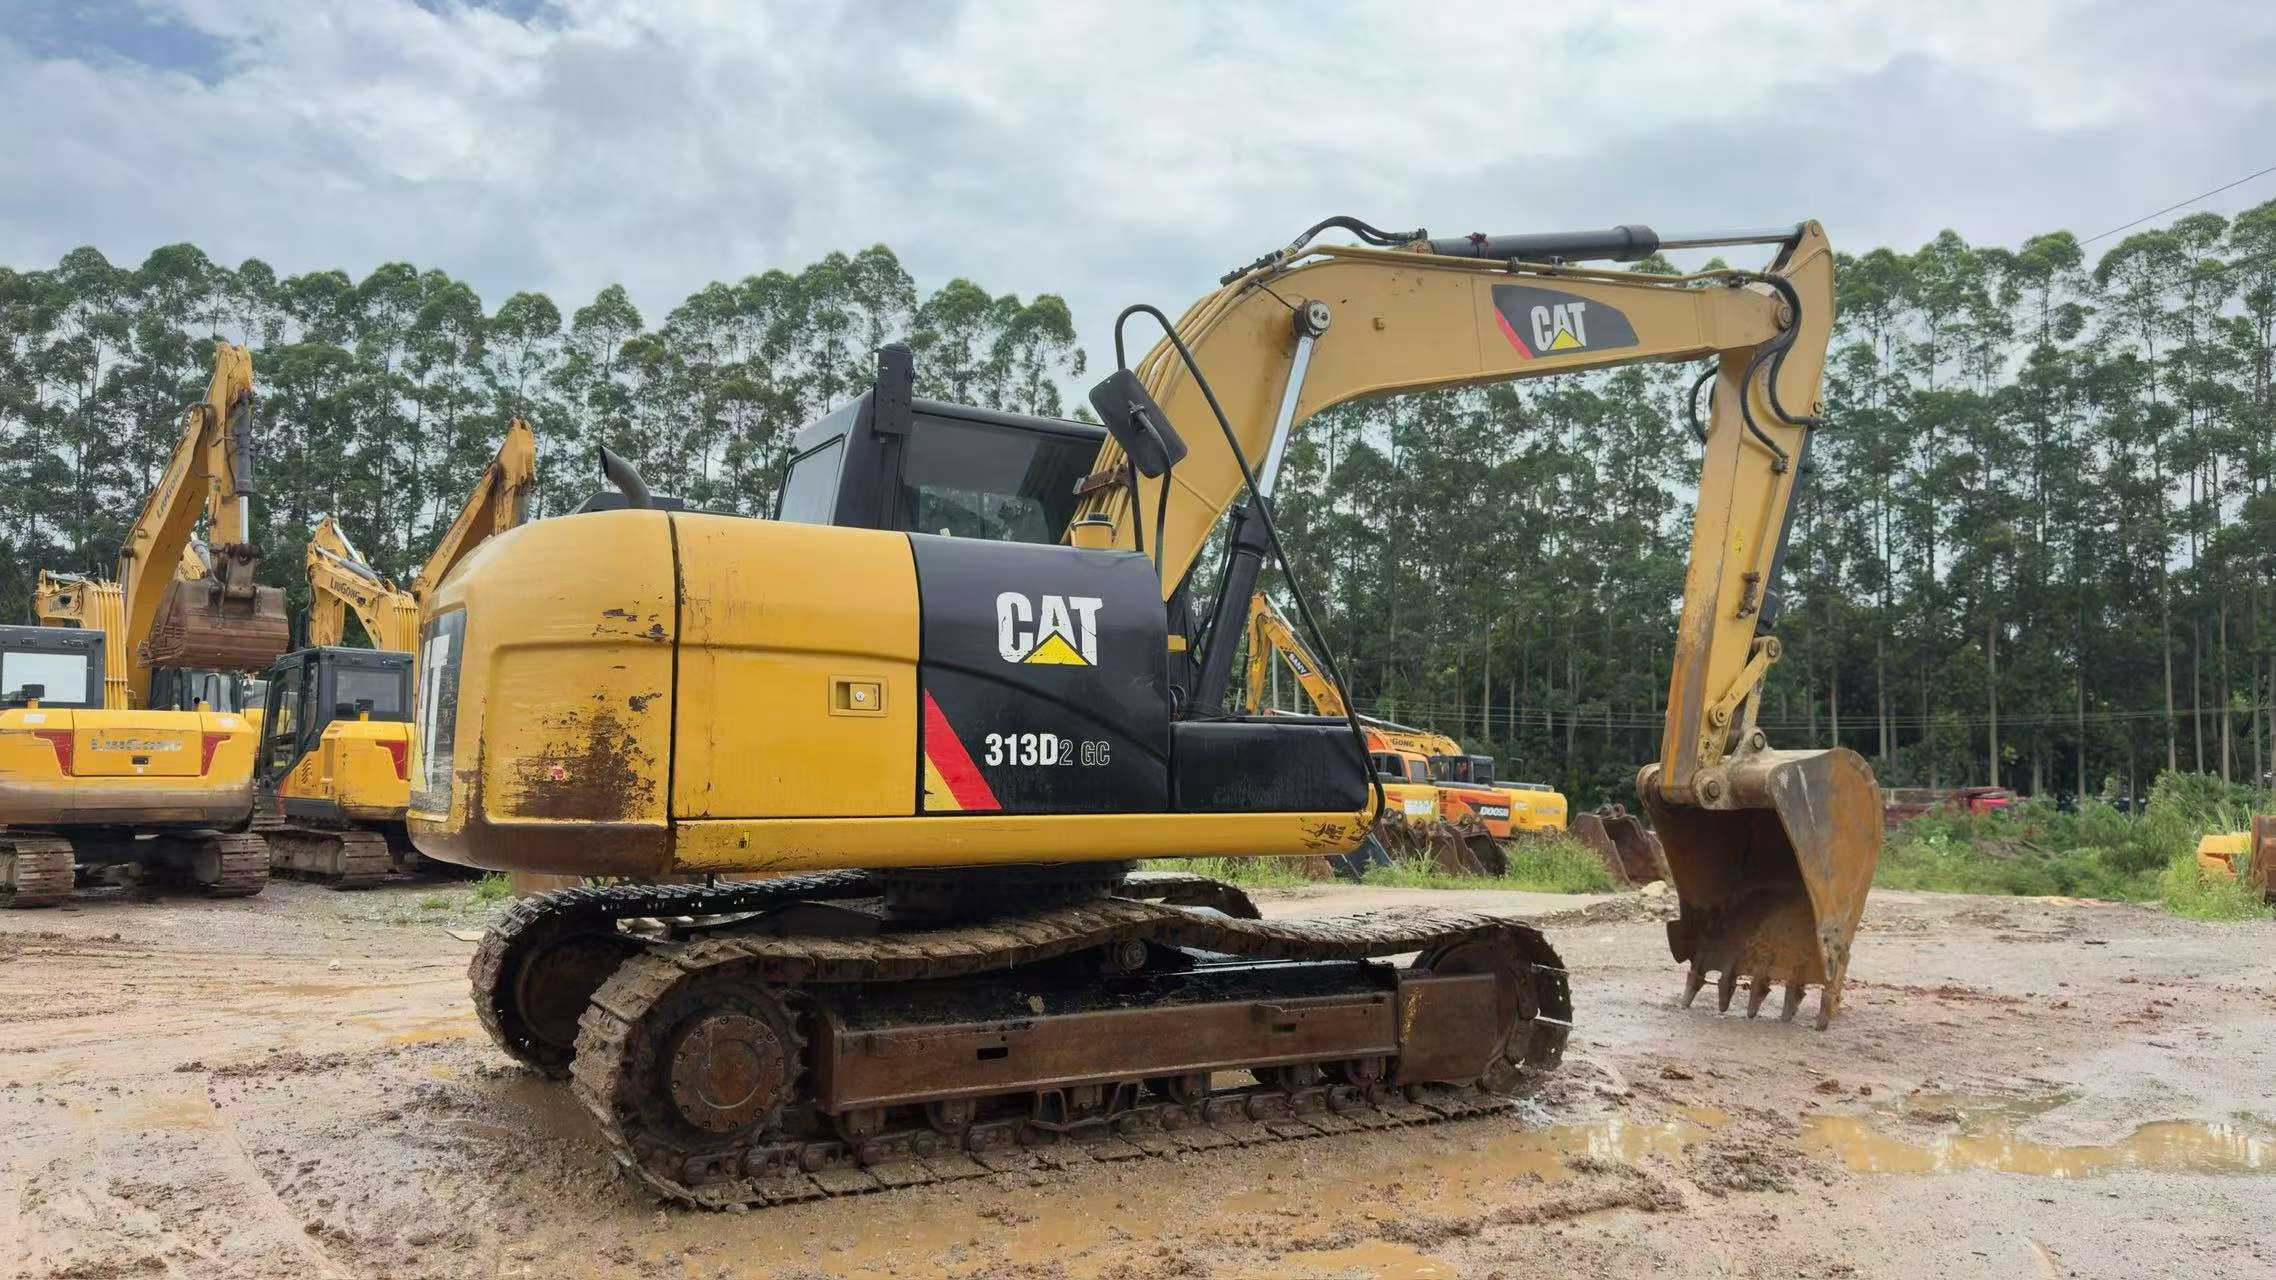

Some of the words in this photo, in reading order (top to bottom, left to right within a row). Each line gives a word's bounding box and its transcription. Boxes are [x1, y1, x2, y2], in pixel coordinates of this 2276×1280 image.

[1530, 302, 1586, 351] CAT
[996, 591, 1103, 666] CAT
[1287, 652, 1308, 674] SANY
[984, 733, 1073, 766] 313D2
[1080, 740, 1111, 766] GC
[1391, 737, 1415, 748] GONG
